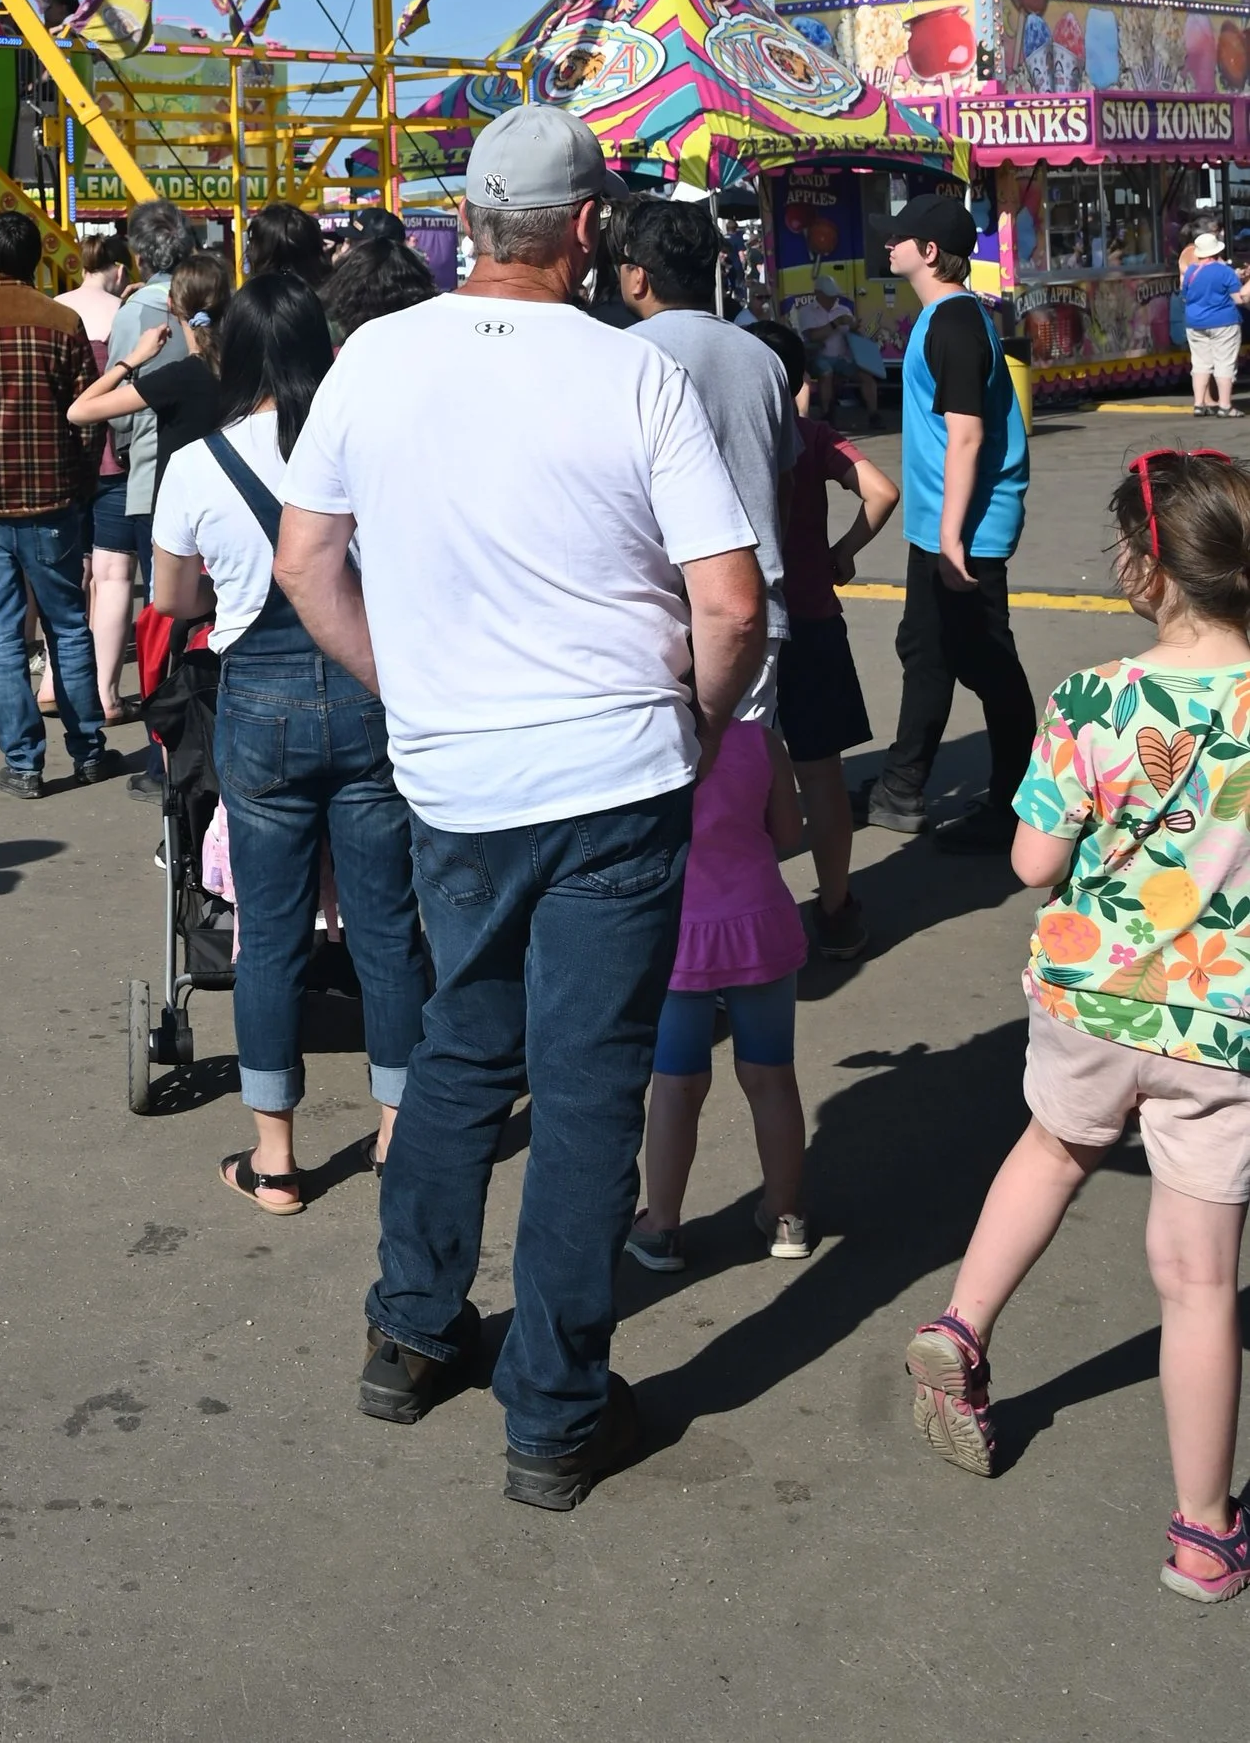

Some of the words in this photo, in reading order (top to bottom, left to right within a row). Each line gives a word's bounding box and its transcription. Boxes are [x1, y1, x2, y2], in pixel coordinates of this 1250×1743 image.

[959, 101, 1007, 109] ICE
[1013, 98, 1088, 109] COLD
[959, 107, 1088, 146] DRINKS
[1101, 100, 1149, 141] SNO
[1156, 101, 1233, 140] KONES
[875, 134, 953, 155] AREA
[786, 189, 838, 207] APPLES
[1016, 287, 1048, 314] CANDY
[1050, 285, 1087, 309] APPLES
